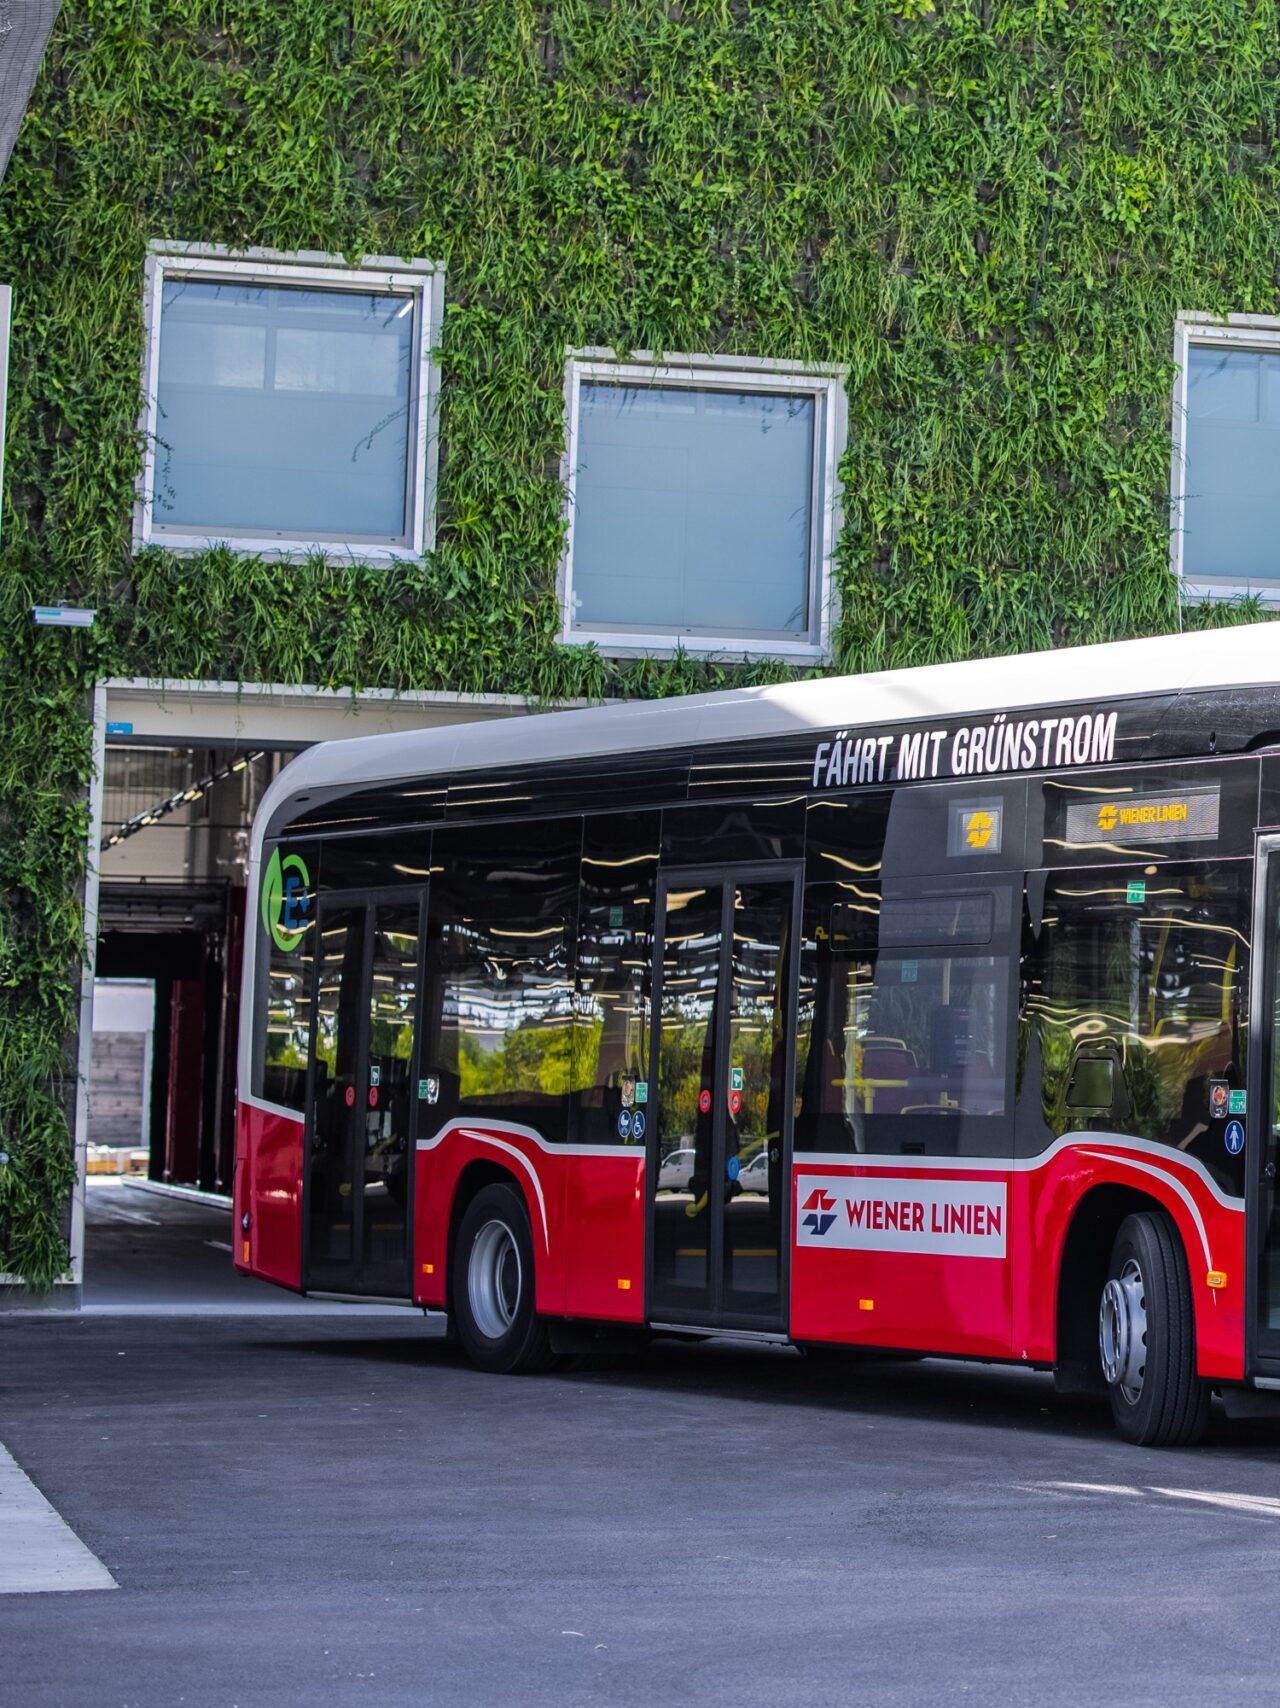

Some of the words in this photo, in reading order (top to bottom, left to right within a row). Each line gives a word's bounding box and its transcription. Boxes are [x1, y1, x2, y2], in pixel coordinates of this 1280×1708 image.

[812, 732, 893, 787] FÄHRT
[898, 731, 947, 780] MIT
[951, 712, 1118, 773] GRÜNSTROM
[1120, 808, 1155, 824] WIENER
[845, 1199, 924, 1232] WIENER
[931, 1203, 1001, 1236] LINIEN
